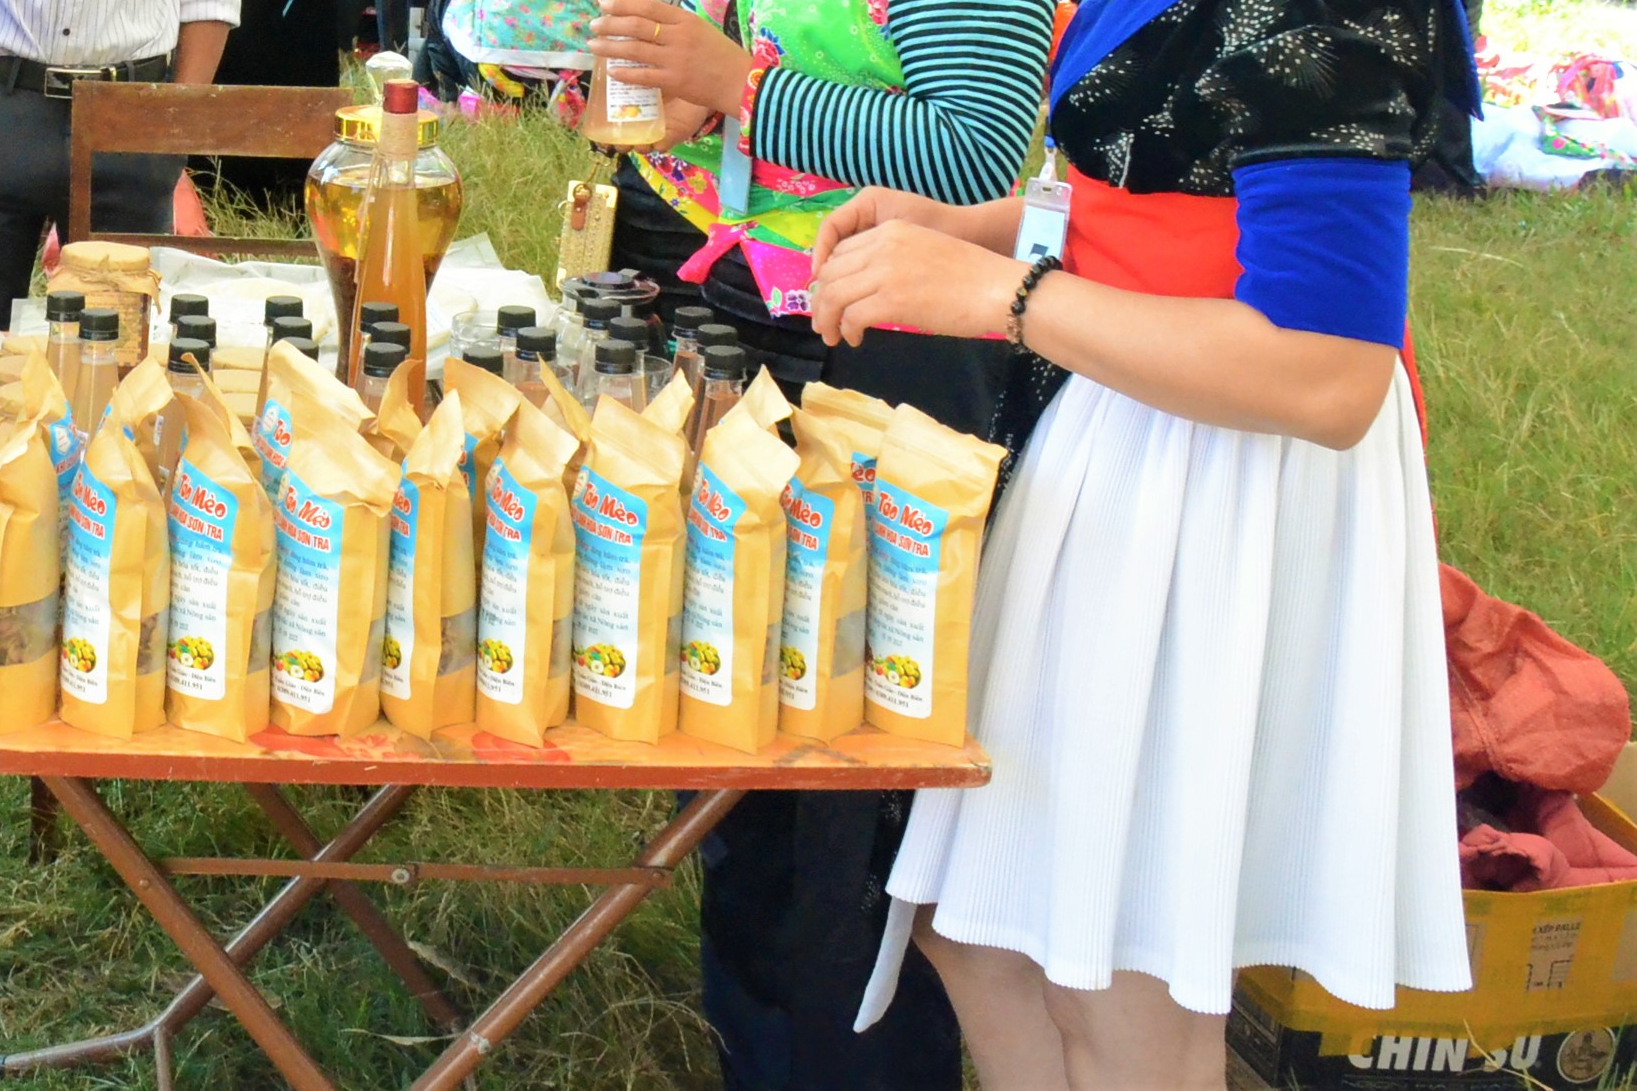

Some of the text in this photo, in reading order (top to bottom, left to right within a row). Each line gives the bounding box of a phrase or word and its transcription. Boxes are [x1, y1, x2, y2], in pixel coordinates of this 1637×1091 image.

[83, 484, 107, 517] Mèo
[192, 484, 228, 519] Mèo
[299, 500, 332, 530] Mèo
[600, 494, 639, 527] Mèo
[790, 499, 822, 528] Mèo
[877, 491, 899, 521] Táo
[900, 505, 934, 536] Mèo
[92, 517, 105, 539] TRA
[187, 514, 204, 535] SƠN
[206, 523, 224, 543] TRA
[297, 527, 311, 547] SƠN
[313, 534, 332, 554] TRA
[598, 522, 613, 540] SƠN
[614, 529, 633, 546] TRA
[802, 534, 818, 551] TRA
[913, 540, 931, 558] TRA
